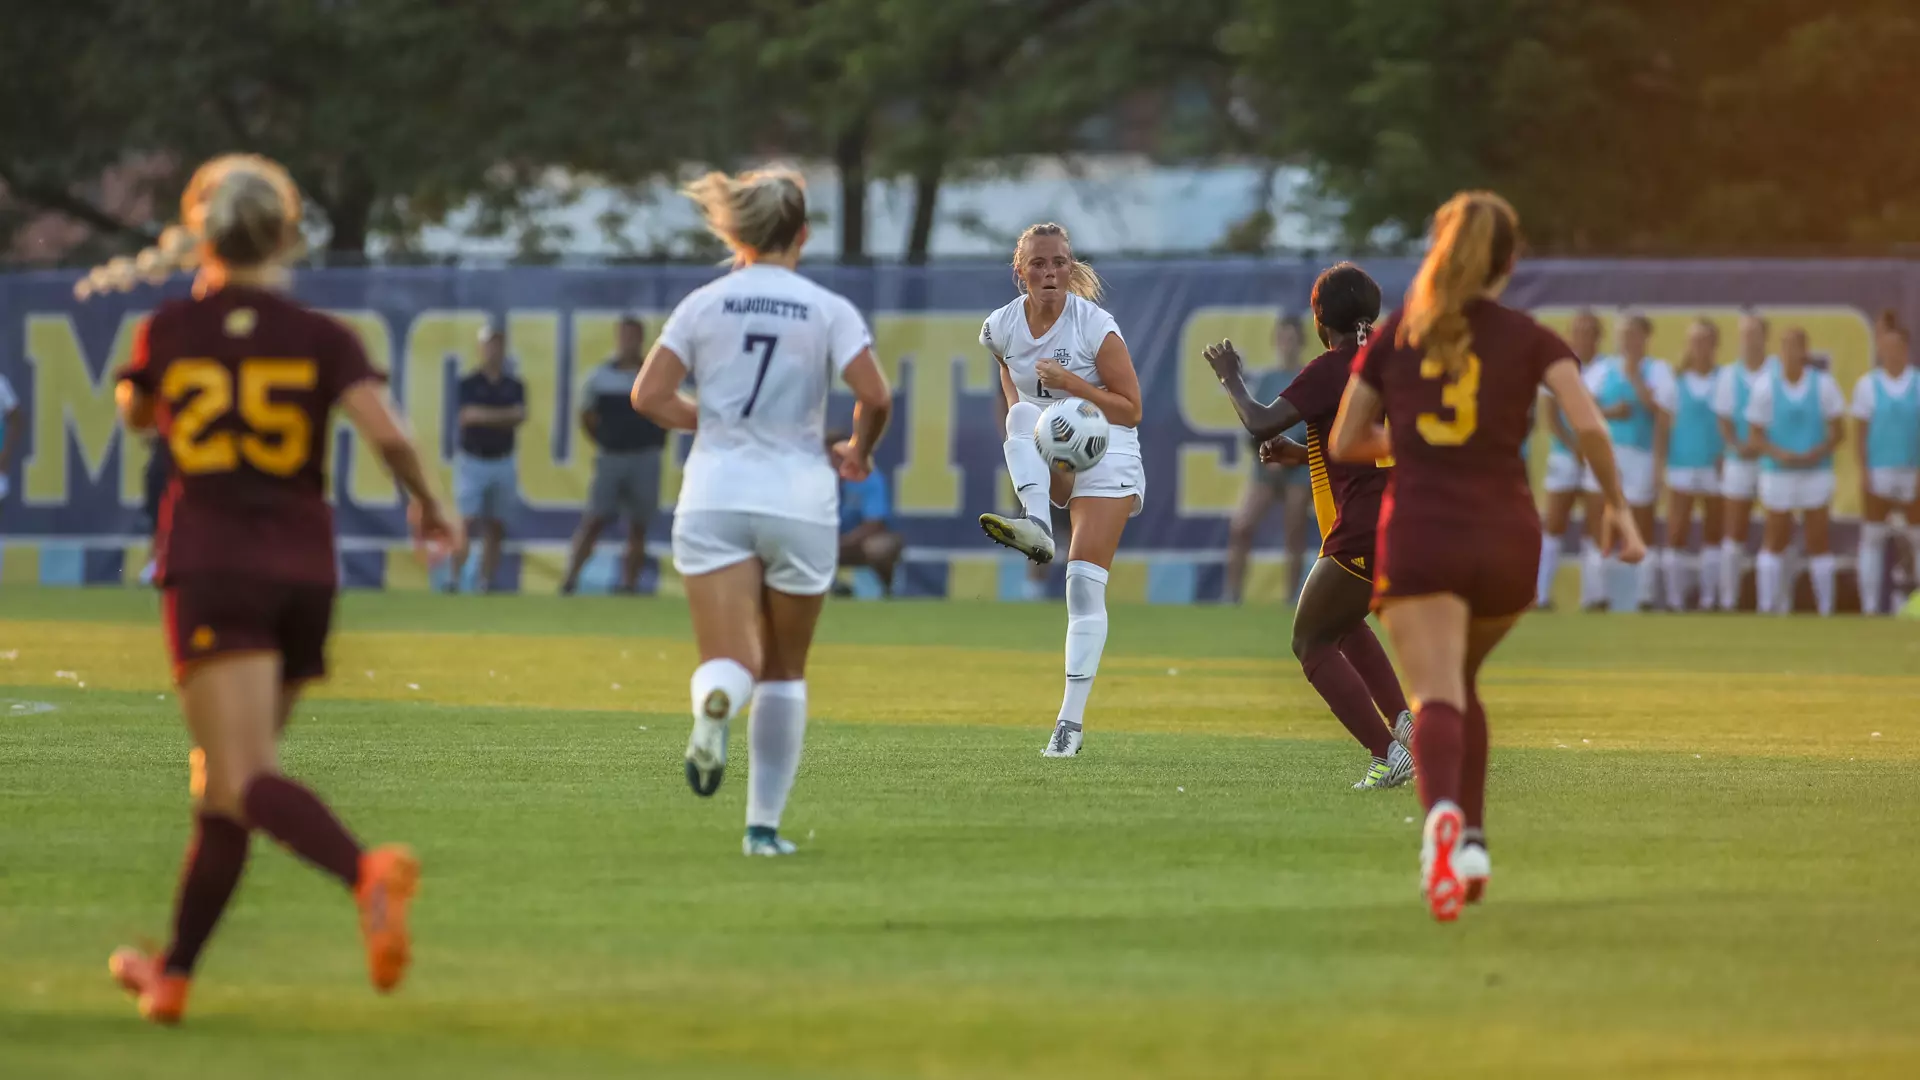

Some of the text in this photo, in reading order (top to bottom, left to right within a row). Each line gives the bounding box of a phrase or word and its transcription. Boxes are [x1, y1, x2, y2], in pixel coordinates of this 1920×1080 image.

[722, 297, 810, 321] MARQUETTE
[162, 358, 318, 478] 25
[741, 333, 779, 418] 7
[1416, 348, 1482, 446] 3
